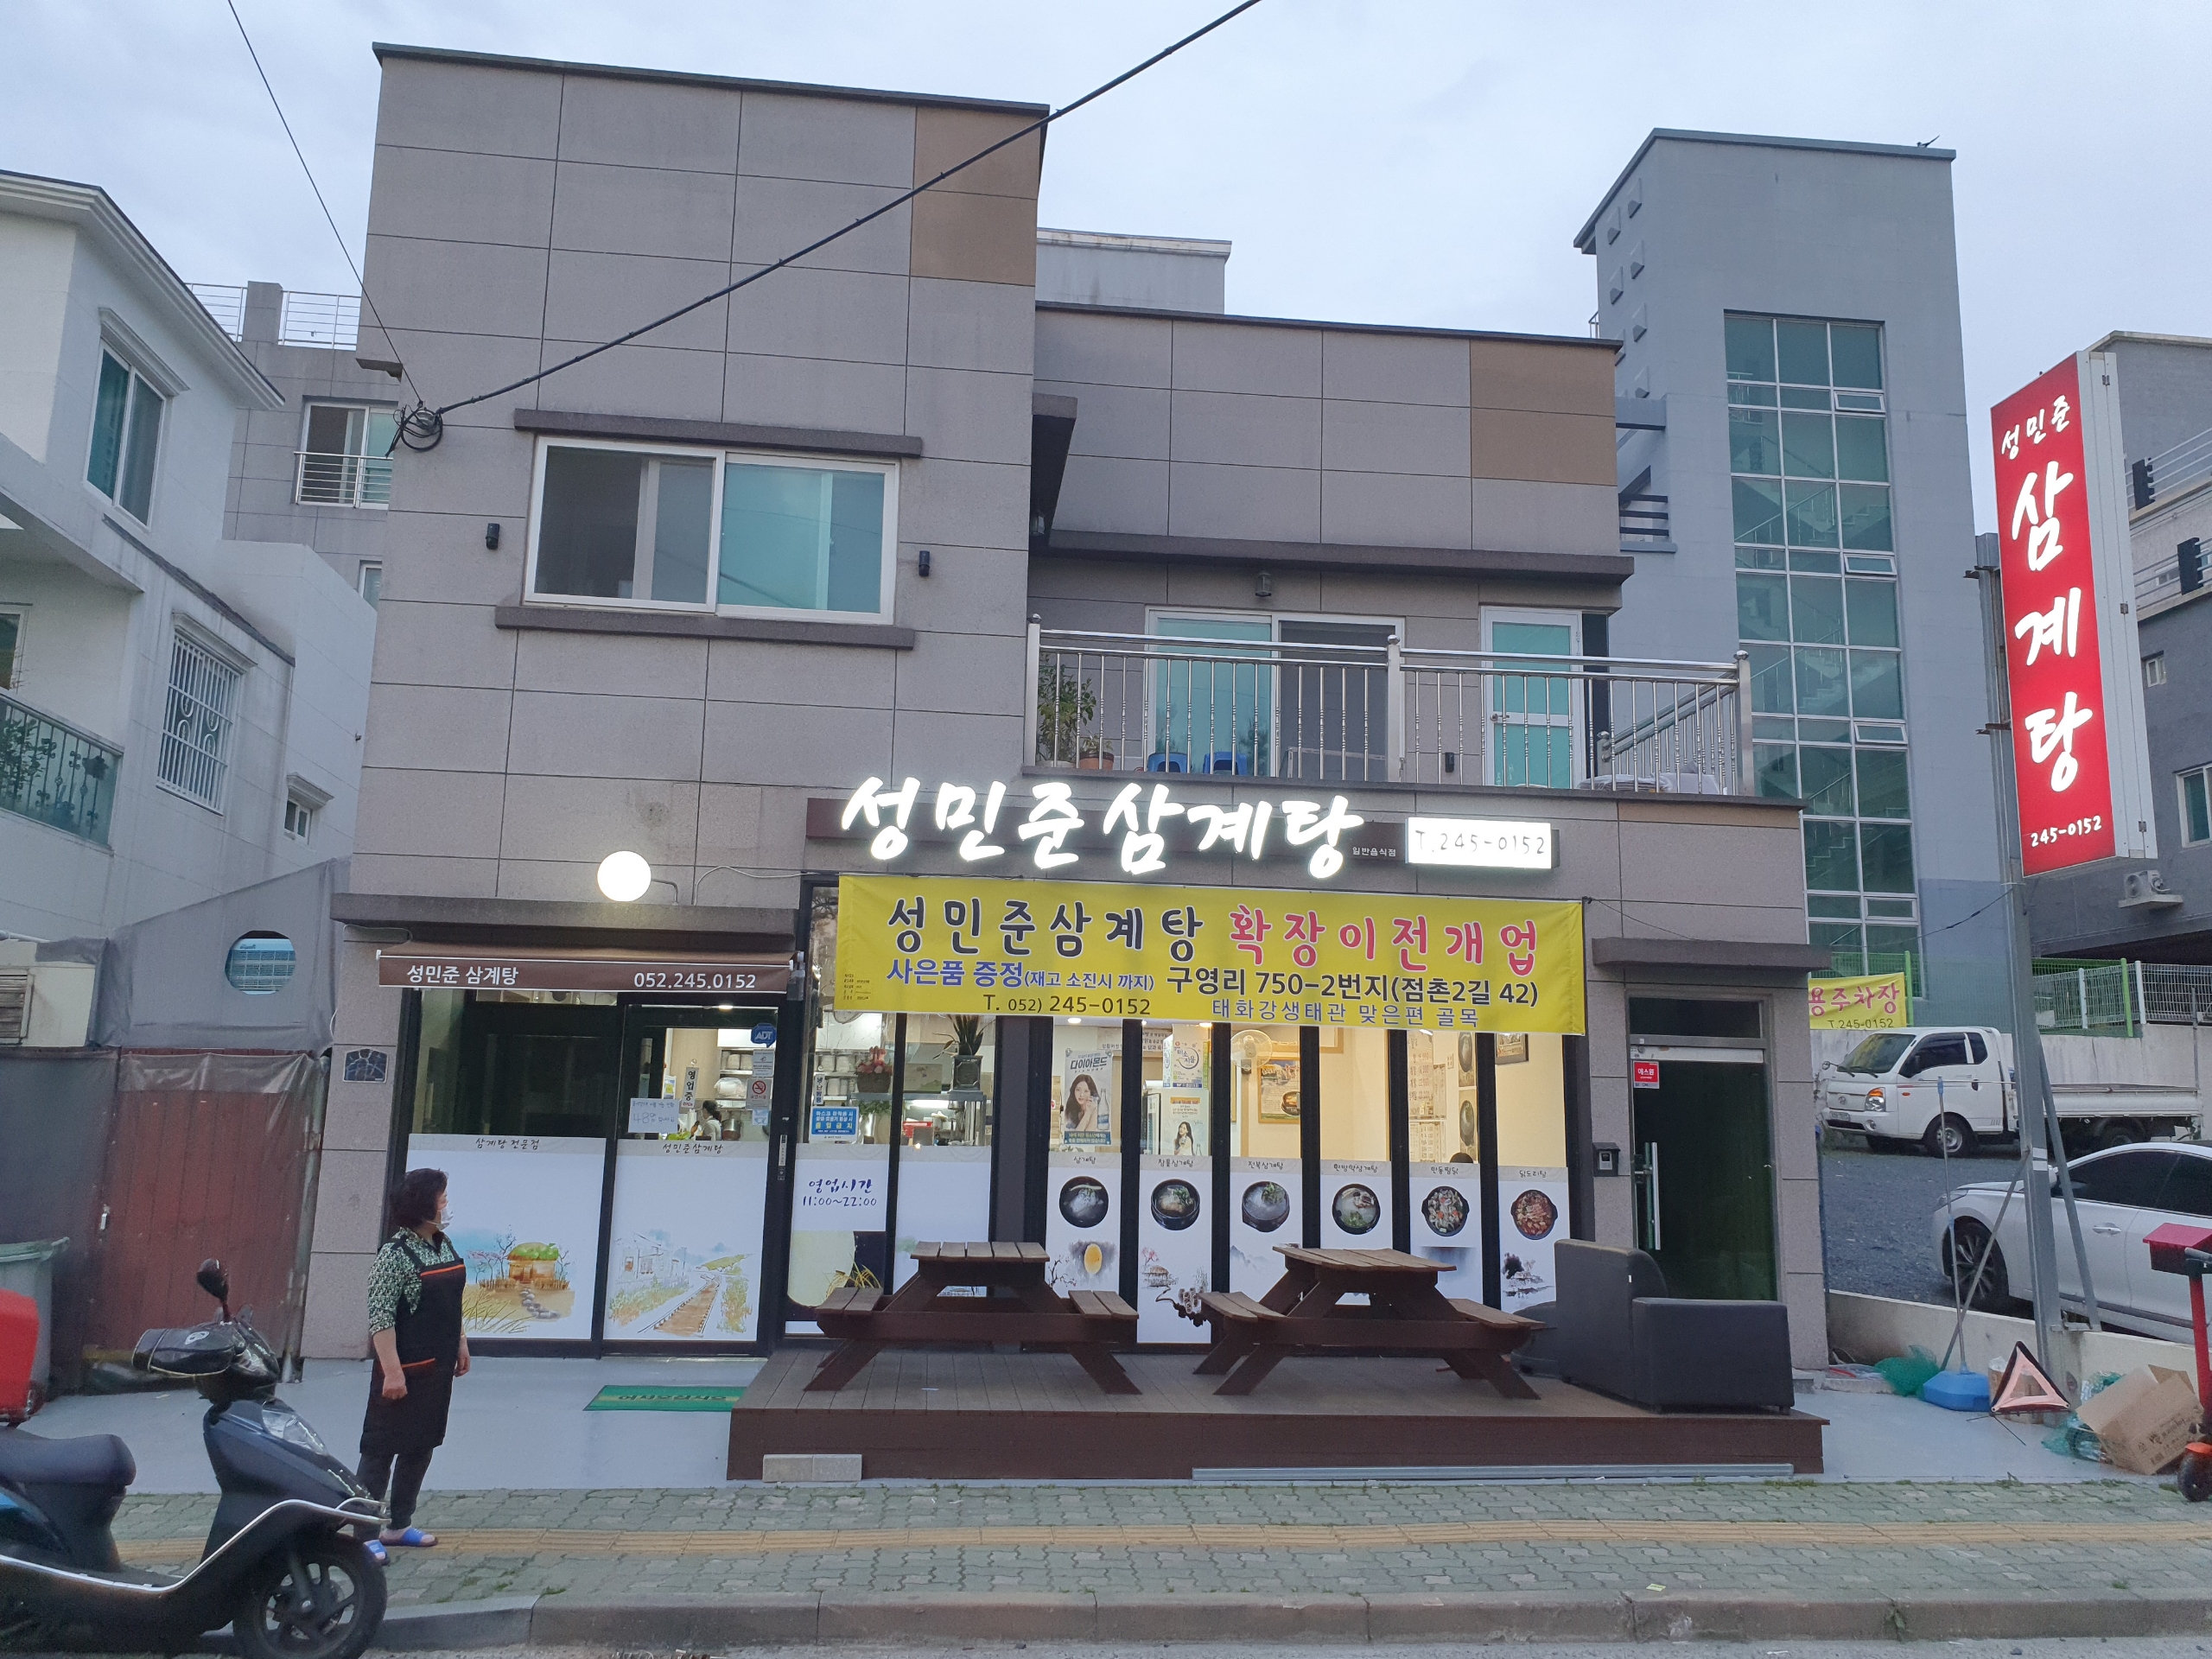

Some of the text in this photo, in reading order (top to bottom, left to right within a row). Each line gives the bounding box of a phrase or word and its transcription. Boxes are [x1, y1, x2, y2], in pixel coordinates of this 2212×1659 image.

[2001, 395, 2071, 461] 성민준
[2012, 461, 2094, 792] 삼계탕
[841, 776, 1364, 880] 성민준삼계탕
[2031, 815, 2102, 848] 245-0152
[1351, 846, 1396, 857] 일반음식점
[887, 896, 1538, 976] 성민준삼계탕 확장이전개업
[407, 965, 756, 990] 성민준 삼계탕 052.245.0152
[887, 959, 965, 987] 사은품
[1065, 969, 1113, 990] 소진시
[1117, 970, 1154, 991] 까지)
[1166, 966, 1246, 995] 구영리
[1499, 982, 1539, 1007] 42)
[1007, 998, 1043, 1014] 052)
[1049, 995, 1151, 1016] 245-0152
[1211, 998, 1479, 1029] 태화강생태관 맞은편 골목
[1827, 1018, 1895, 1029] T.245-0152
[754, 1031, 773, 1041] ADT
[1070, 1057, 1109, 1070] 다이아몬드
[684, 1071, 697, 1102] 영업중
[475, 1138, 540, 1151] 삼계탕 전문점
[662, 1142, 724, 1154] 성민준삼계탕
[1073, 1155, 1096, 1165] 삼계탕
[1519, 1169, 1548, 1179] 닭도리탕
[808, 1179, 874, 1194] 영업시간
[802, 1196, 877, 1207] 11:00~22:00
